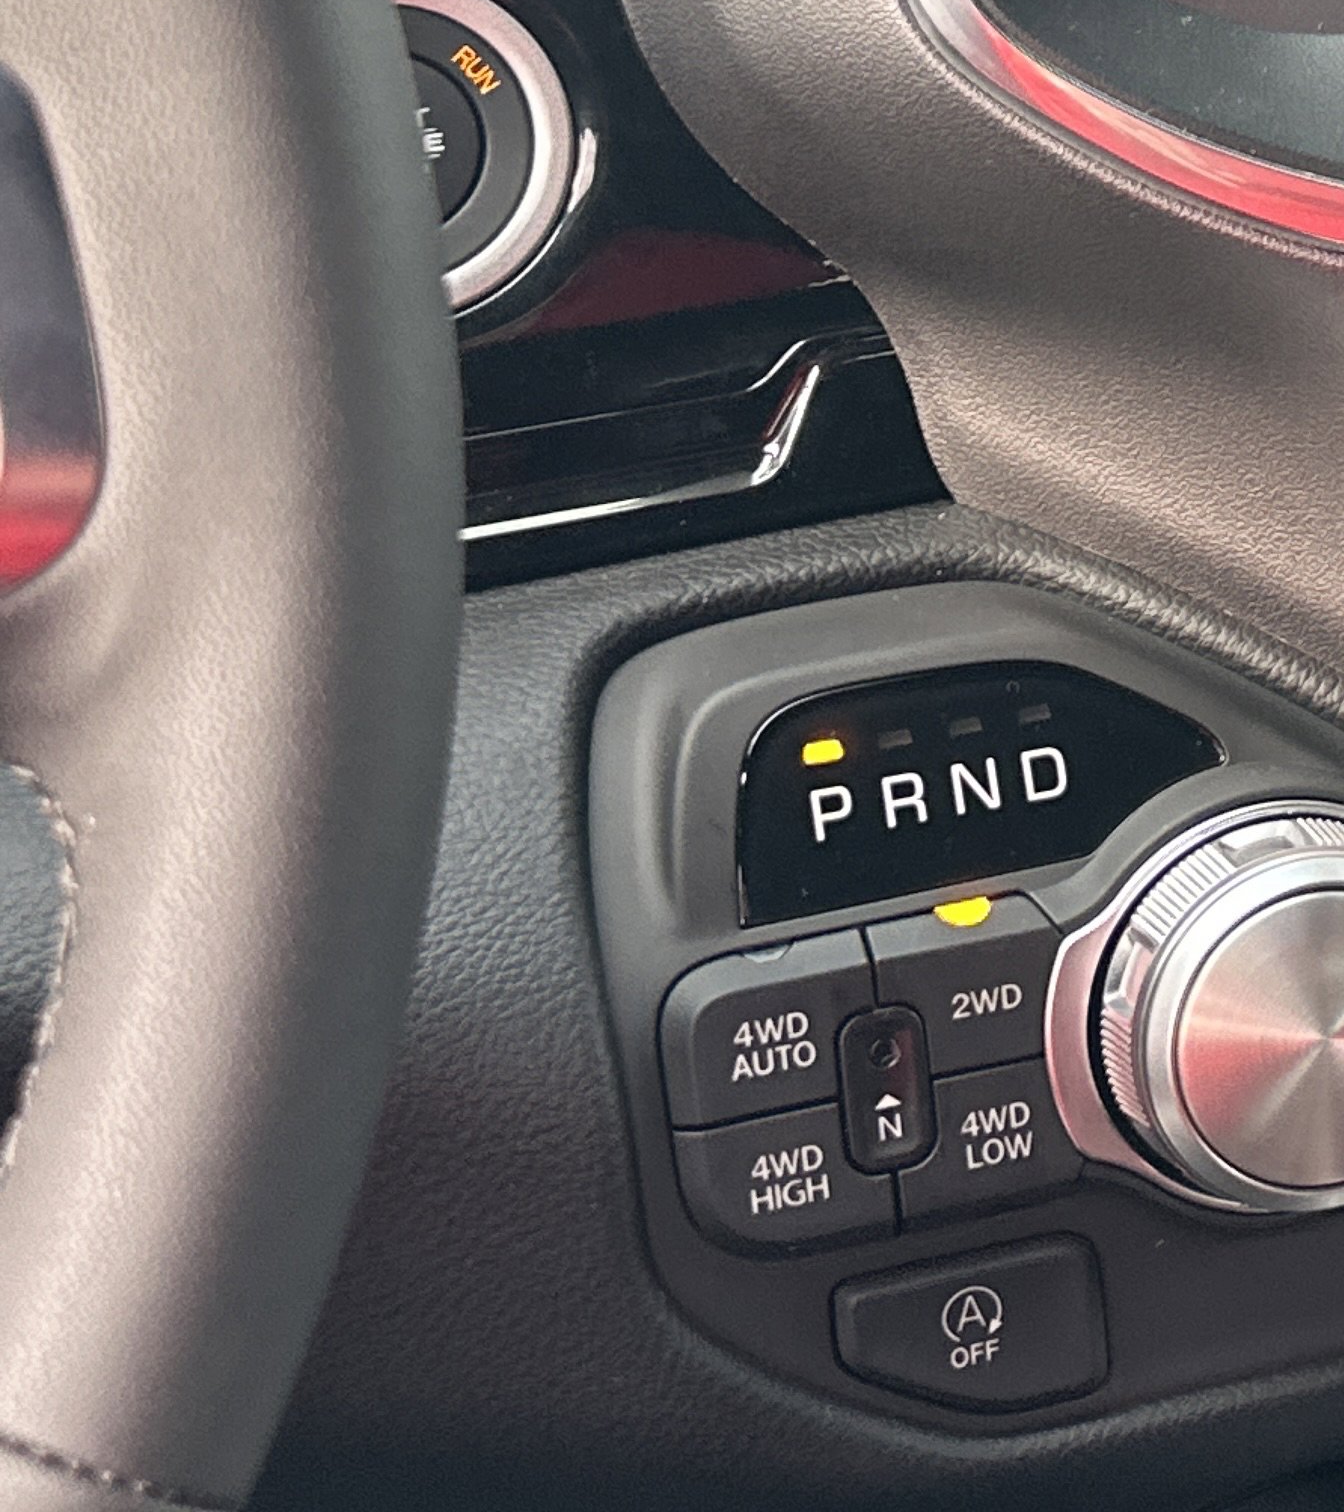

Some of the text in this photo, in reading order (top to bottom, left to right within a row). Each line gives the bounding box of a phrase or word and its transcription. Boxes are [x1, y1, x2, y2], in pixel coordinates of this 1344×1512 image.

[451, 44, 501, 95] RUN
[951, 983, 1022, 1020] 2WD
[733, 1011, 810, 1047] 4WD
[731, 1041, 817, 1082] AUTO
[878, 1112, 903, 1141] N
[961, 1101, 1033, 1137] 4WD
[751, 1144, 824, 1180] 4WD
[966, 1132, 1033, 1170] LOW
[750, 1175, 830, 1214] HIGH
[949, 1339, 999, 1369] OFF
